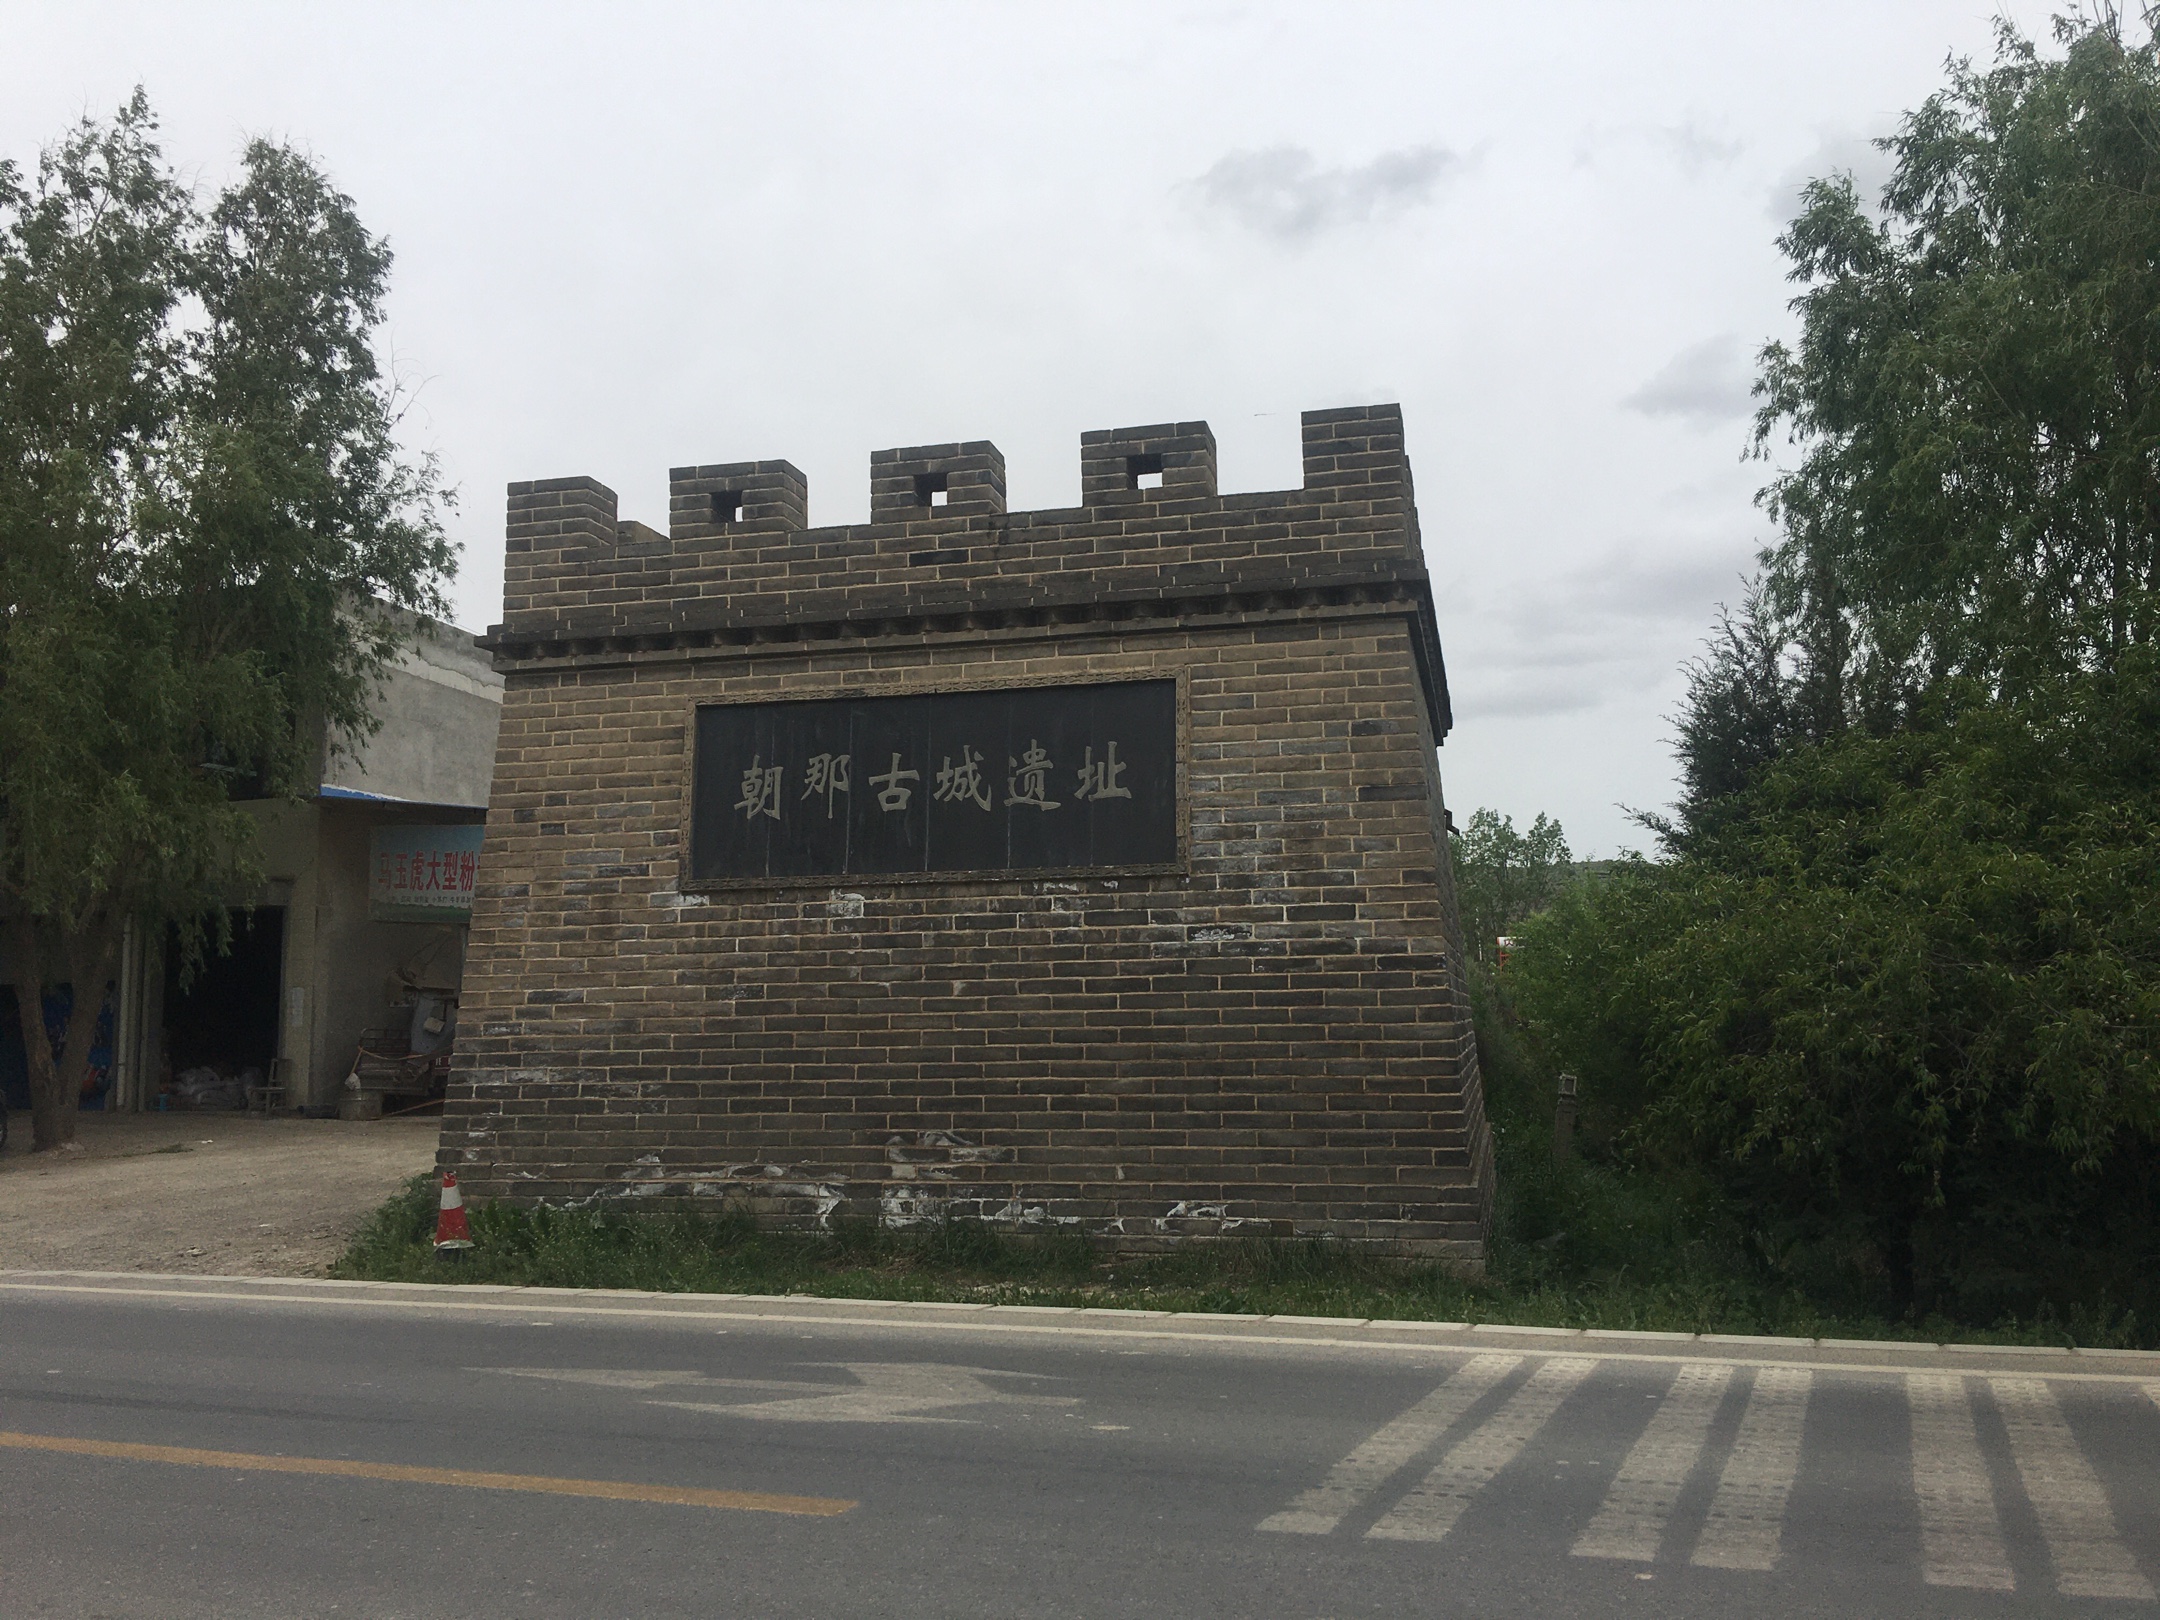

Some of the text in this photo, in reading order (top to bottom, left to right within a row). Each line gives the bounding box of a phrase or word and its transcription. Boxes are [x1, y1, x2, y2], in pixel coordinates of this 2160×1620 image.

[733, 738, 1132, 821] 朝那古城遗址
[378, 850, 481, 892] 马玉虎大型粉
